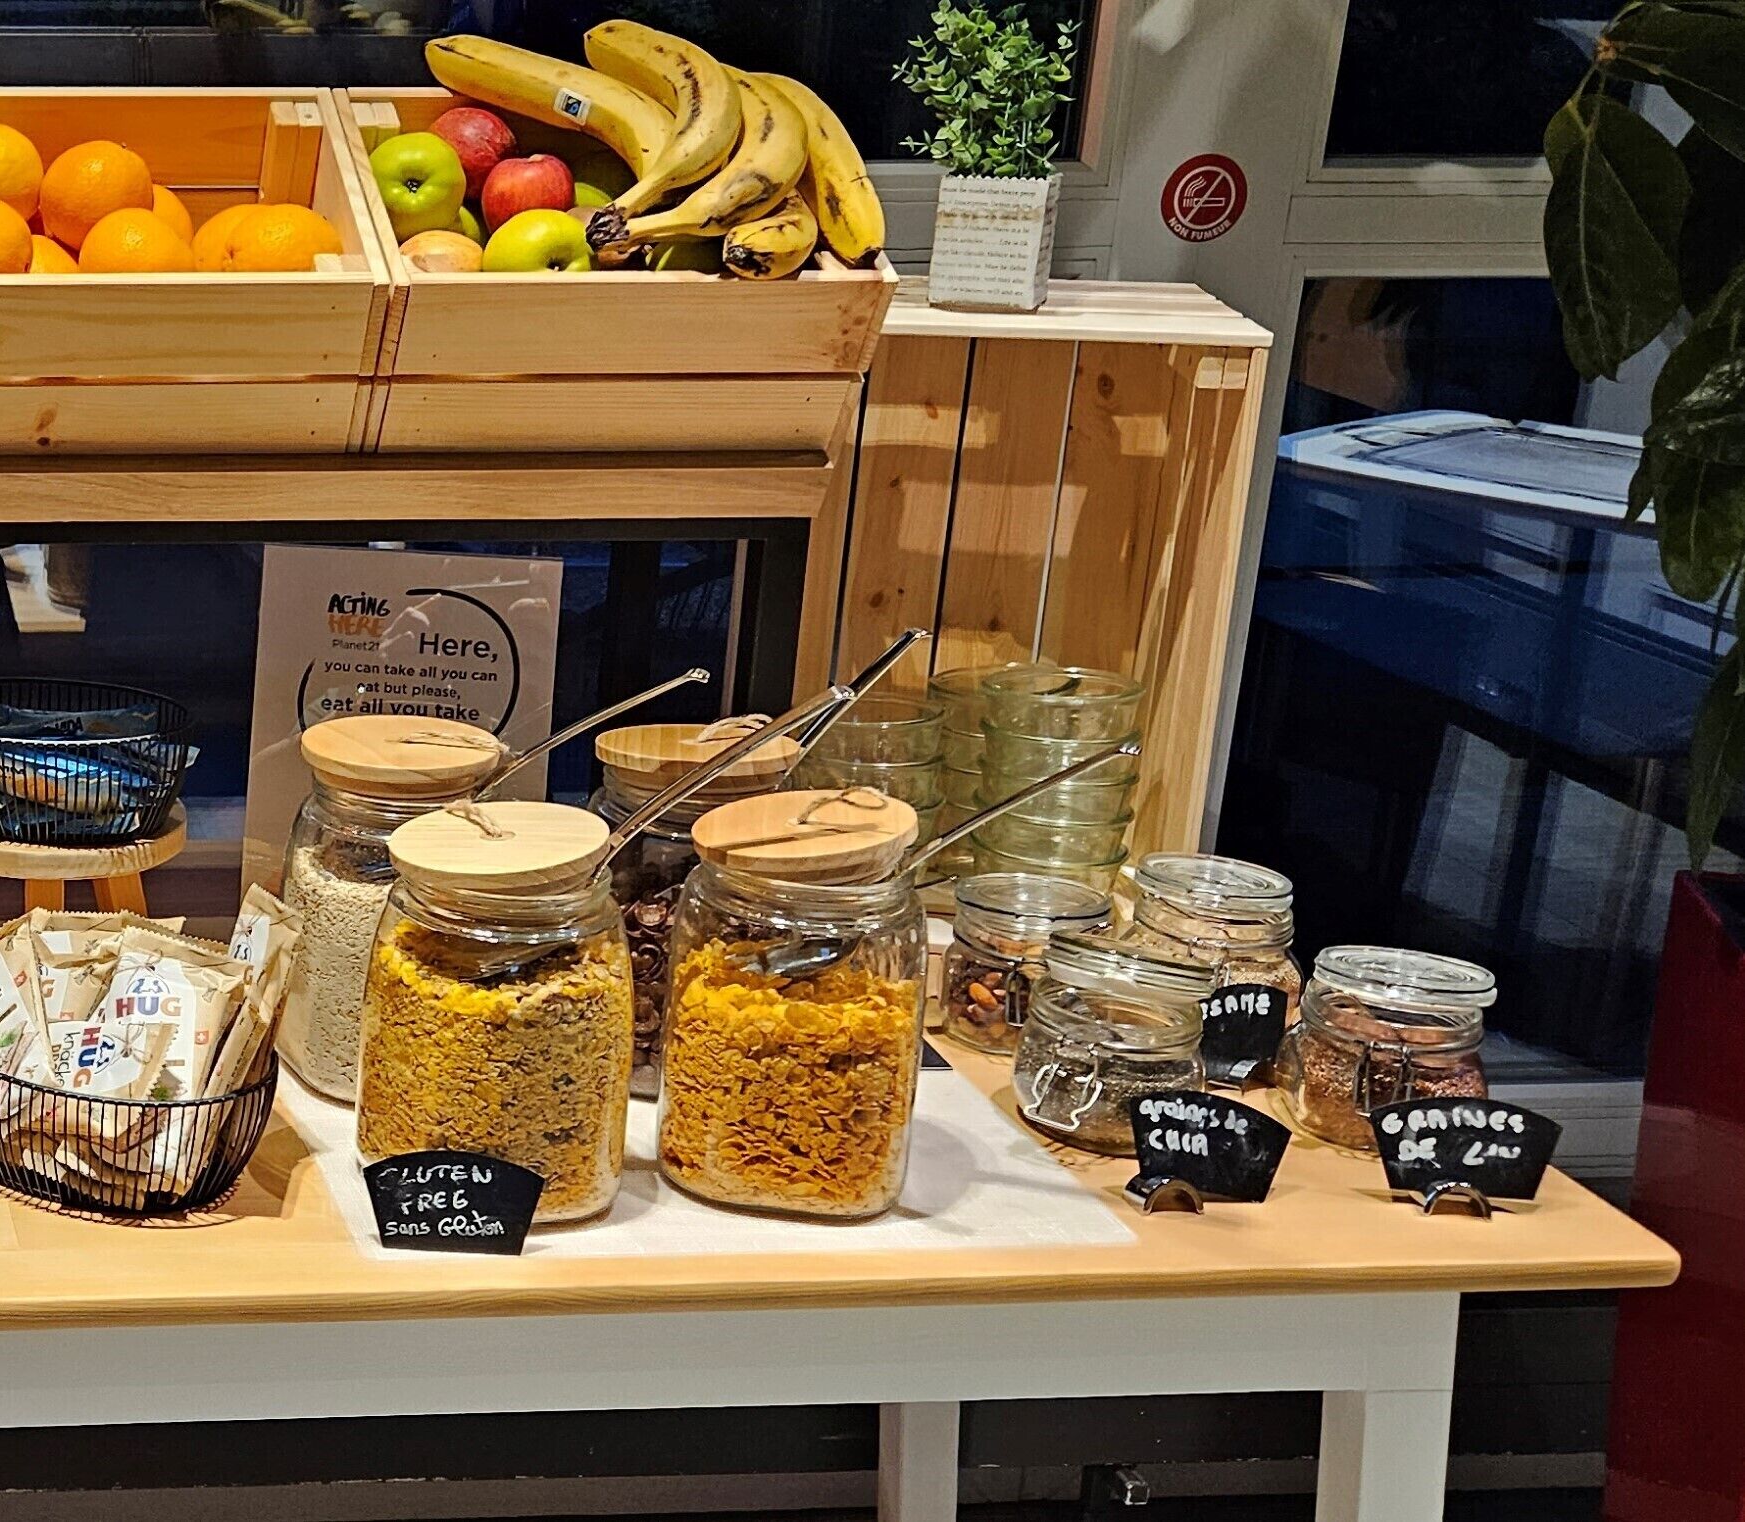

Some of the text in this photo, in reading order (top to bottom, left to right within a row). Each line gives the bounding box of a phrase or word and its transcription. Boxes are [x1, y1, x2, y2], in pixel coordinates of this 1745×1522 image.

[1168, 217, 1232, 240] NON FUMEUR
[327, 614, 386, 637] HERE
[419, 632, 498, 662] Here,
[325, 661, 497, 685] you can take all you can
[357, 681, 461, 700] eat but please,
[321, 697, 480, 721] eat all you take
[115, 997, 181, 1018] HUG
[1200, 992, 1271, 1020] SAME
[72, 1026, 102, 1089] HUG
[1224, 1109, 1249, 1135] de
[1381, 1105, 1525, 1135] GRAINES
[1149, 1128, 1209, 1157] CHIA
[1398, 1137, 1522, 1166] DE LIN
[376, 1165, 493, 1191] GLUTEN
